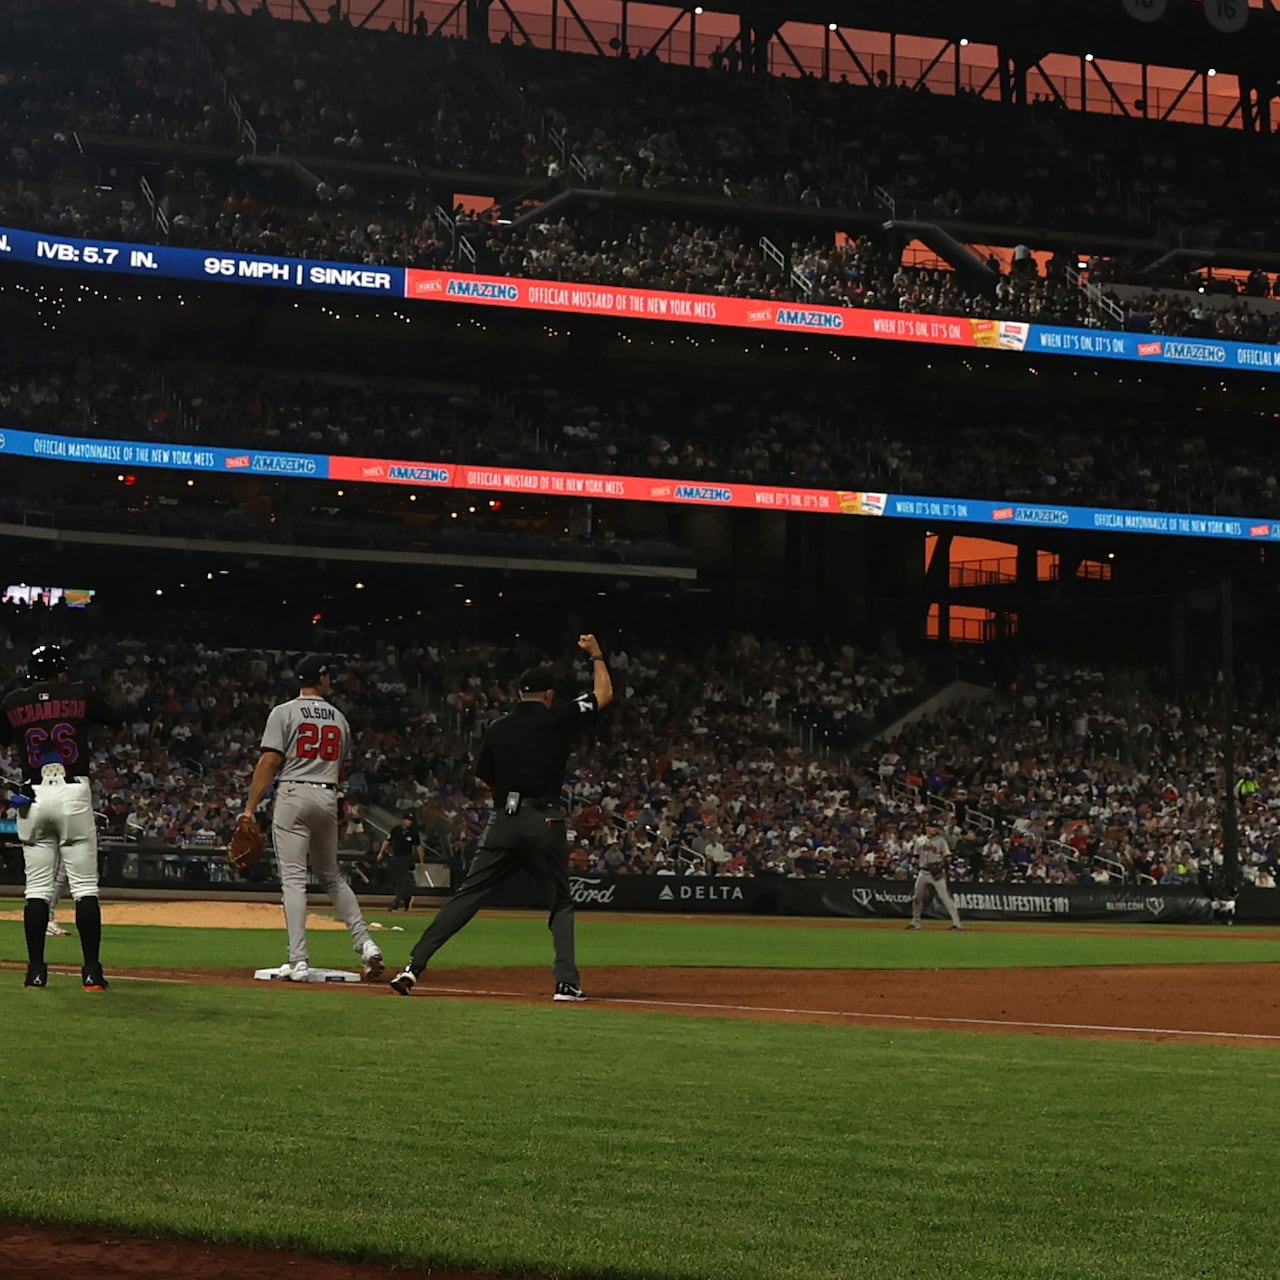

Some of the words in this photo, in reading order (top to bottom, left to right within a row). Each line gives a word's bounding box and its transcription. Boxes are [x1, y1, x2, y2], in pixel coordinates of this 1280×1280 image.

[37, 241, 80, 262] IVB:
[82, 246, 119, 265] 5.7
[130, 250, 158, 269] IN.
[204, 257, 235, 276] 95
[238, 260, 289, 280] MPH
[310, 266, 391, 289] SINKER
[446, 278, 519, 301] AMAZING
[528, 286, 569, 305] OFFICIAL
[572, 290, 612, 310] MUSTARD
[616, 294, 627, 311] OF
[630, 295, 644, 312] THE
[647, 297, 667, 314] NEW
[670, 300, 692, 316] YORK
[694, 301, 716, 318] METS
[776, 308, 843, 329] AMAZING
[1164, 341, 1226, 362] AMAZING
[34, 438, 66, 455] OFFICIAL
[68, 442, 120, 461] MAYONNAISE
[123, 446, 133, 461] OF
[136, 448, 149, 462] THE
[152, 449, 170, 464] NEW
[172, 451, 192, 465] YORK
[194, 452, 214, 466] METS
[252, 455, 316, 473] AMAZING
[387, 465, 449, 482] AMAZING
[674, 484, 732, 502] AMAZING
[300, 707, 335, 721] OLSON
[297, 723, 341, 761] 28
[569, 876, 616, 904] Ford
[680, 886, 744, 900] DELTA
[953, 894, 1003, 910] BASEBALL
[1004, 894, 1052, 912] LIFESTYLE
[1054, 897, 1070, 912] 101
